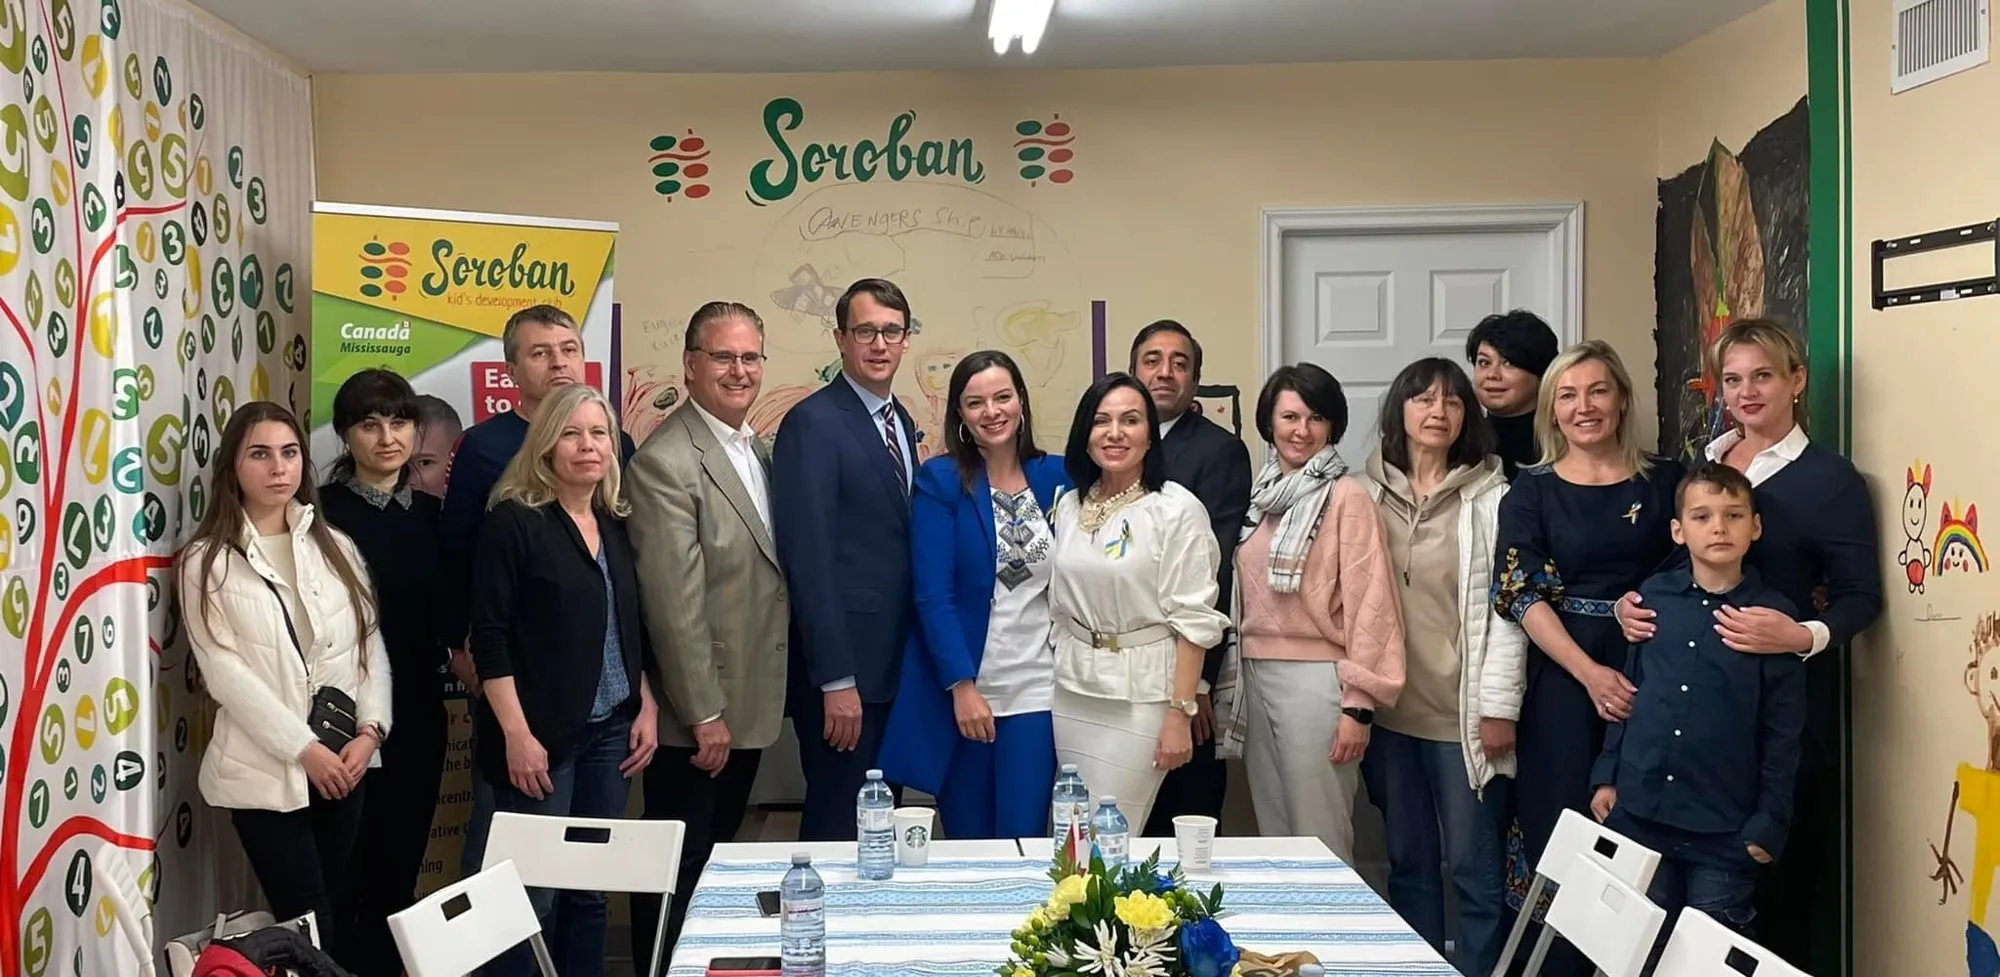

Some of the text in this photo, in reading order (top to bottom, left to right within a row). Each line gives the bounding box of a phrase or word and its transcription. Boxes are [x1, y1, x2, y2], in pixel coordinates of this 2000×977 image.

[747, 97, 985, 203] Soroban
[216, 199, 227, 238] 5
[251, 181, 265, 220] 3
[163, 225, 184, 262] 3
[421, 239, 575, 297] Soroban
[447, 292, 472, 306] kid's
[475, 292, 538, 311] development
[341, 321, 411, 340] Canada
[340, 342, 411, 357] Mississauga
[485, 368, 519, 389] Ea
[485, 395, 512, 414] to
[149, 422, 182, 475] 5
[57, 566, 66, 597] 3
[79, 624, 90, 660] 7
[106, 687, 132, 724] 5
[116, 759, 143, 783] 4
[71, 856, 86, 907] 4
[31, 915, 46, 975] 5
